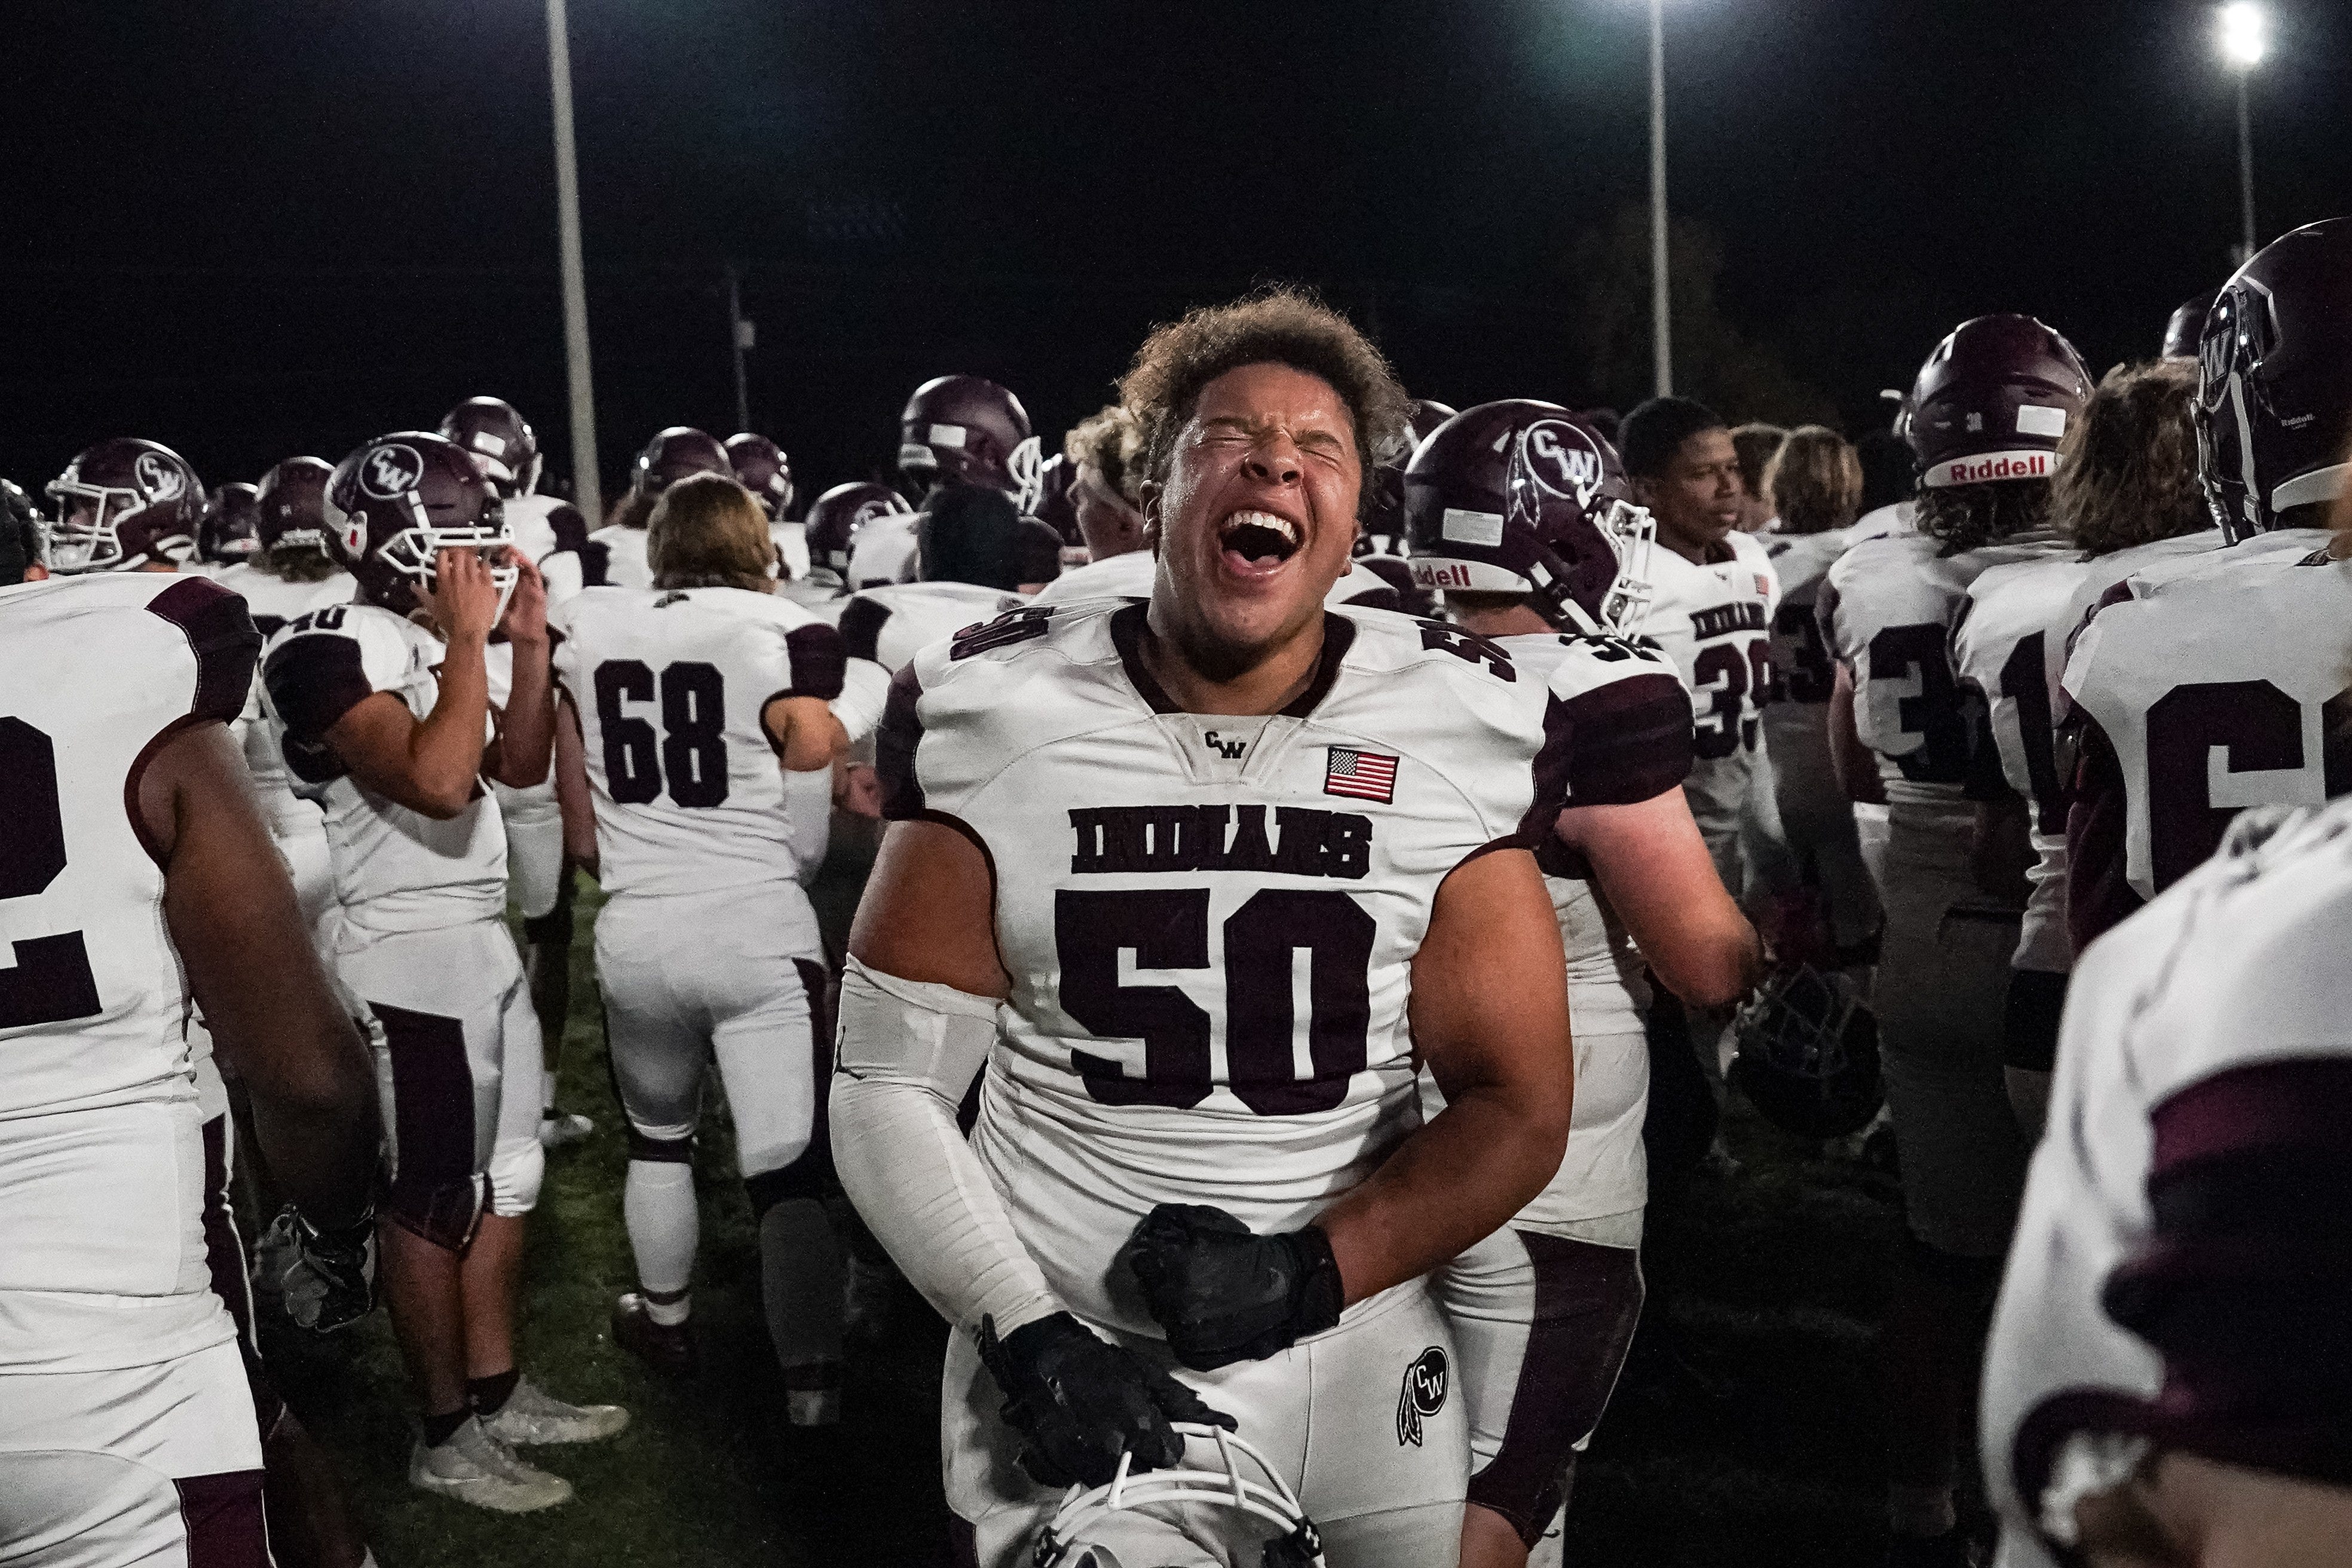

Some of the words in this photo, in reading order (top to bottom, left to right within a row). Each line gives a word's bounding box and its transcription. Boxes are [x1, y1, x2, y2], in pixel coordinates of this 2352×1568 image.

[372, 449, 414, 491] CW
[1532, 429, 1595, 483] CW
[1950, 455, 2044, 480] Riddell
[593, 659, 730, 808] 68
[1204, 731, 1247, 759] CW
[1067, 804, 1373, 880] INDIANS
[1054, 888, 1376, 1116] 50
[1416, 1364, 1444, 1400] CW
